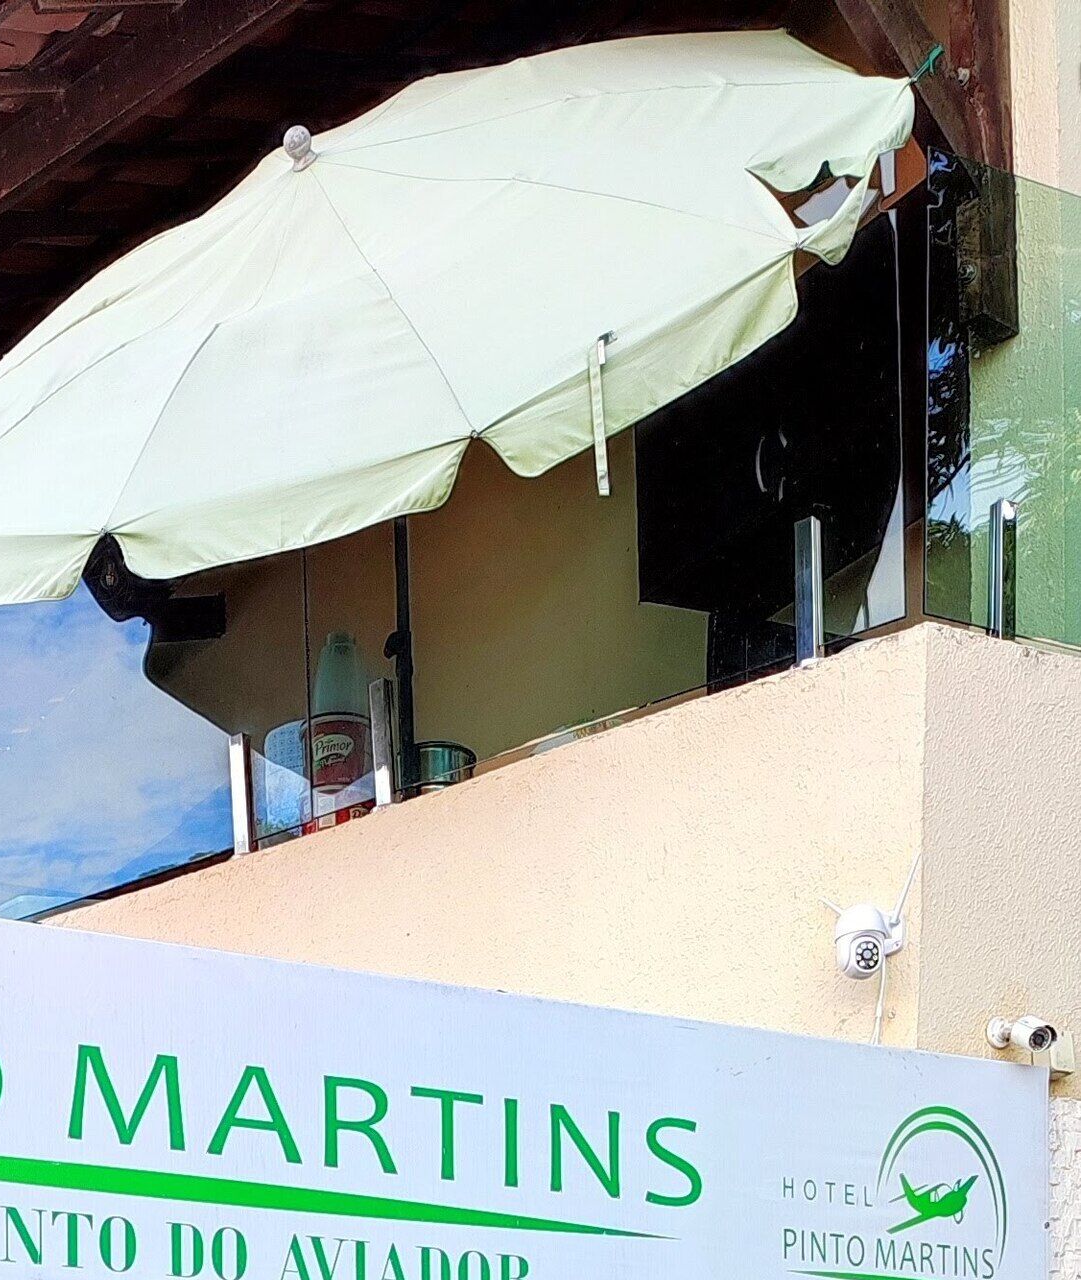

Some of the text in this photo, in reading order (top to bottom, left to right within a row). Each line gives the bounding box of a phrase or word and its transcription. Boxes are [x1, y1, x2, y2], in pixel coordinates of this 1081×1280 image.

[315, 740, 352, 757] Primor
[68, 1043, 703, 1207] MARTINS
[783, 1176, 873, 1208] HOTEL
[783, 1228, 995, 1280] PINTO MARTINS
